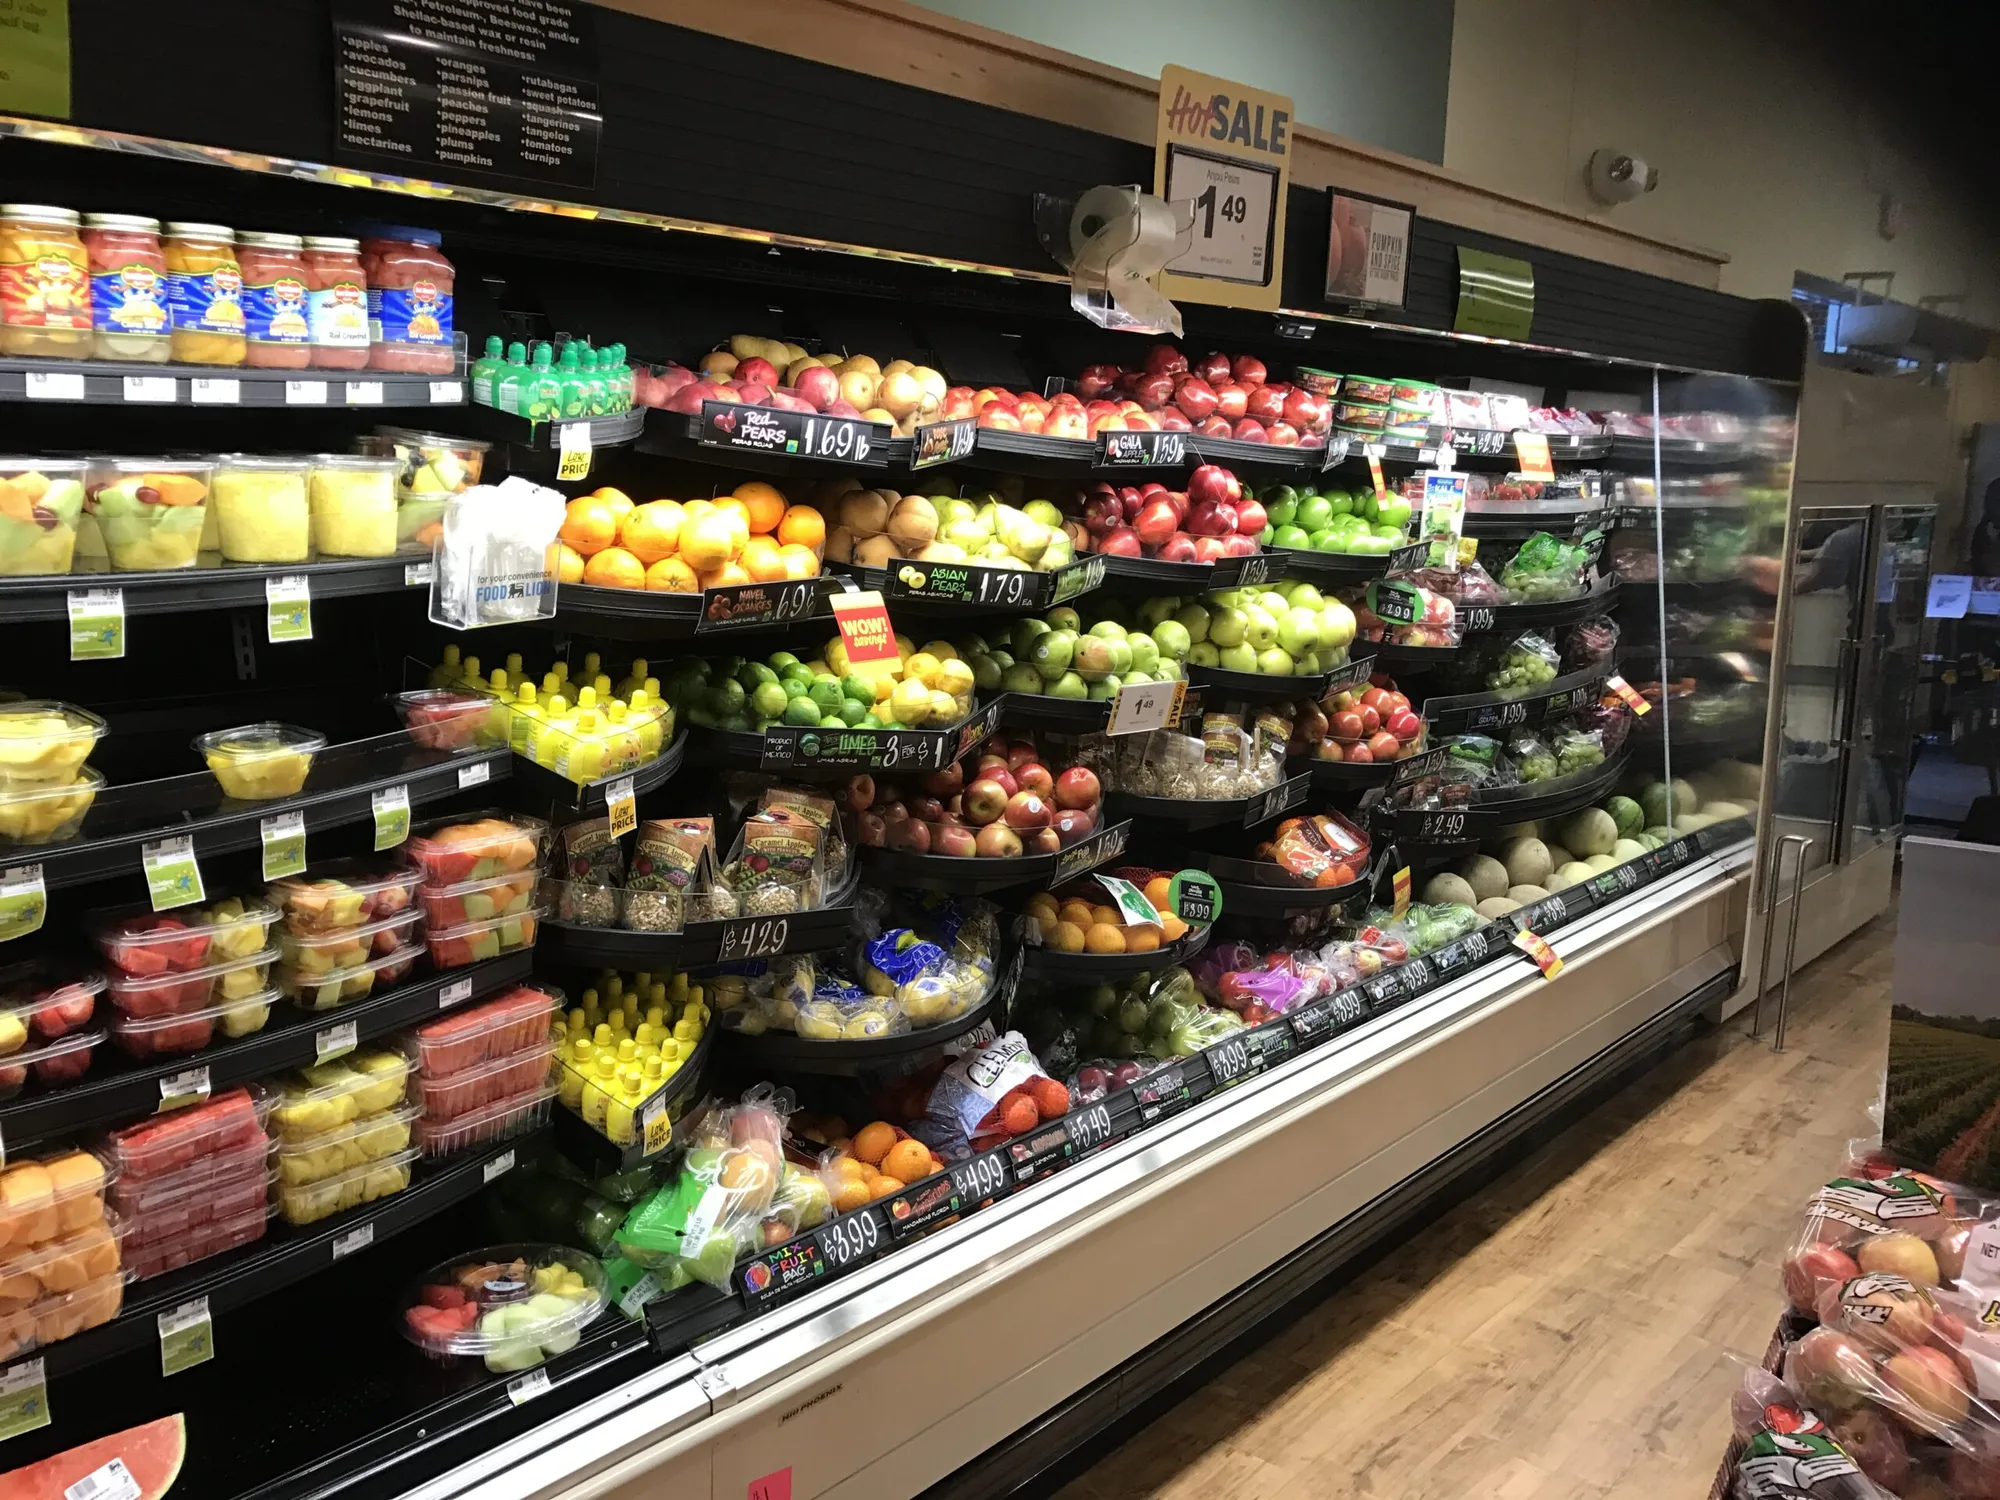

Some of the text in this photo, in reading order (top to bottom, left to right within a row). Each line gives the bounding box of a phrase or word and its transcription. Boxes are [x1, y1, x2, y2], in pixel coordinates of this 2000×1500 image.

[512, 6, 536, 21] food
[539, 15, 569, 29] grade
[545, 3, 572, 17] been
[393, 5, 547, 51] Shellac-based wax or resin
[409, 24, 422, 35] to
[425, 29, 477, 49] maintain
[548, 30, 580, 45] and/or
[347, 37, 389, 54] apples
[348, 51, 407, 71] avocados
[441, 58, 486, 75] oranges
[349, 65, 416, 86] cucumbers
[441, 71, 490, 88] parsnips
[525, 76, 578, 94] rutabagas
[349, 80, 403, 97] eggplant
[441, 83, 512, 106] passion fruit
[349, 93, 410, 112] grapefruit
[441, 97, 489, 113] peaches
[526, 88, 597, 110] sweet potatoes
[348, 105, 393, 122] lemons
[441, 111, 486, 127] peppers
[526, 113, 580, 131] tangerines
[348, 119, 382, 134] limes
[440, 123, 501, 142] pineapples
[526, 126, 570, 142] tangelos
[1209, 94, 1289, 155] SALE
[347, 134, 412, 152] nectarines
[440, 137, 475, 150] plums
[525, 138, 573, 155] tomatoes
[439, 150, 493, 166] pumpkins
[524, 150, 561, 166] turnips
[1198, 185, 1247, 239] 1 49
[1372, 232, 1403, 254] PUMPKIN
[1370, 252, 1401, 272] AND SPICE
[744, 411, 779, 426] Red
[741, 418, 870, 462] PEARS 1.69 lb
[1120, 435, 1142, 450] GALA
[561, 463, 589, 475] PRICE
[477, 570, 552, 584] for your convenience
[930, 567, 968, 582] ASIAN
[476, 580, 551, 602] FOOD LION
[739, 588, 767, 601] NAVEL
[931, 580, 966, 593] PEARS
[979, 572, 1022, 604] 1.79
[841, 616, 889, 637] WOW!
[853, 633, 888, 652] savings
[1134, 698, 1154, 715] 1 49
[1168, 697, 1181, 726] SALE
[766, 738, 794, 746] PRODUCT
[882, 734, 899, 768] 3
[901, 744, 916, 759] FOR
[765, 751, 792, 760] MEXICO
[611, 815, 635, 834] PRICE
[1425, 813, 1465, 835] $2.49
[643, 840, 690, 863] Caramel Apples
[755, 837, 807, 850] Caramel Apples
[724, 918, 788, 958] $4.29
[1302, 1006, 1324, 1025] GALA
[1212, 1040, 1249, 1081] $3.99
[1071, 1104, 1112, 1152] $5.49
[645, 1129, 672, 1151] PRICE
[955, 1154, 1005, 1202] $4.99
[768, 1242, 802, 1264] MIX
[782, 1210, 878, 1284] BAG $3.99
[1980, 1242, 2000, 1260] NET
[769, 1246, 816, 1277] FRUIT
